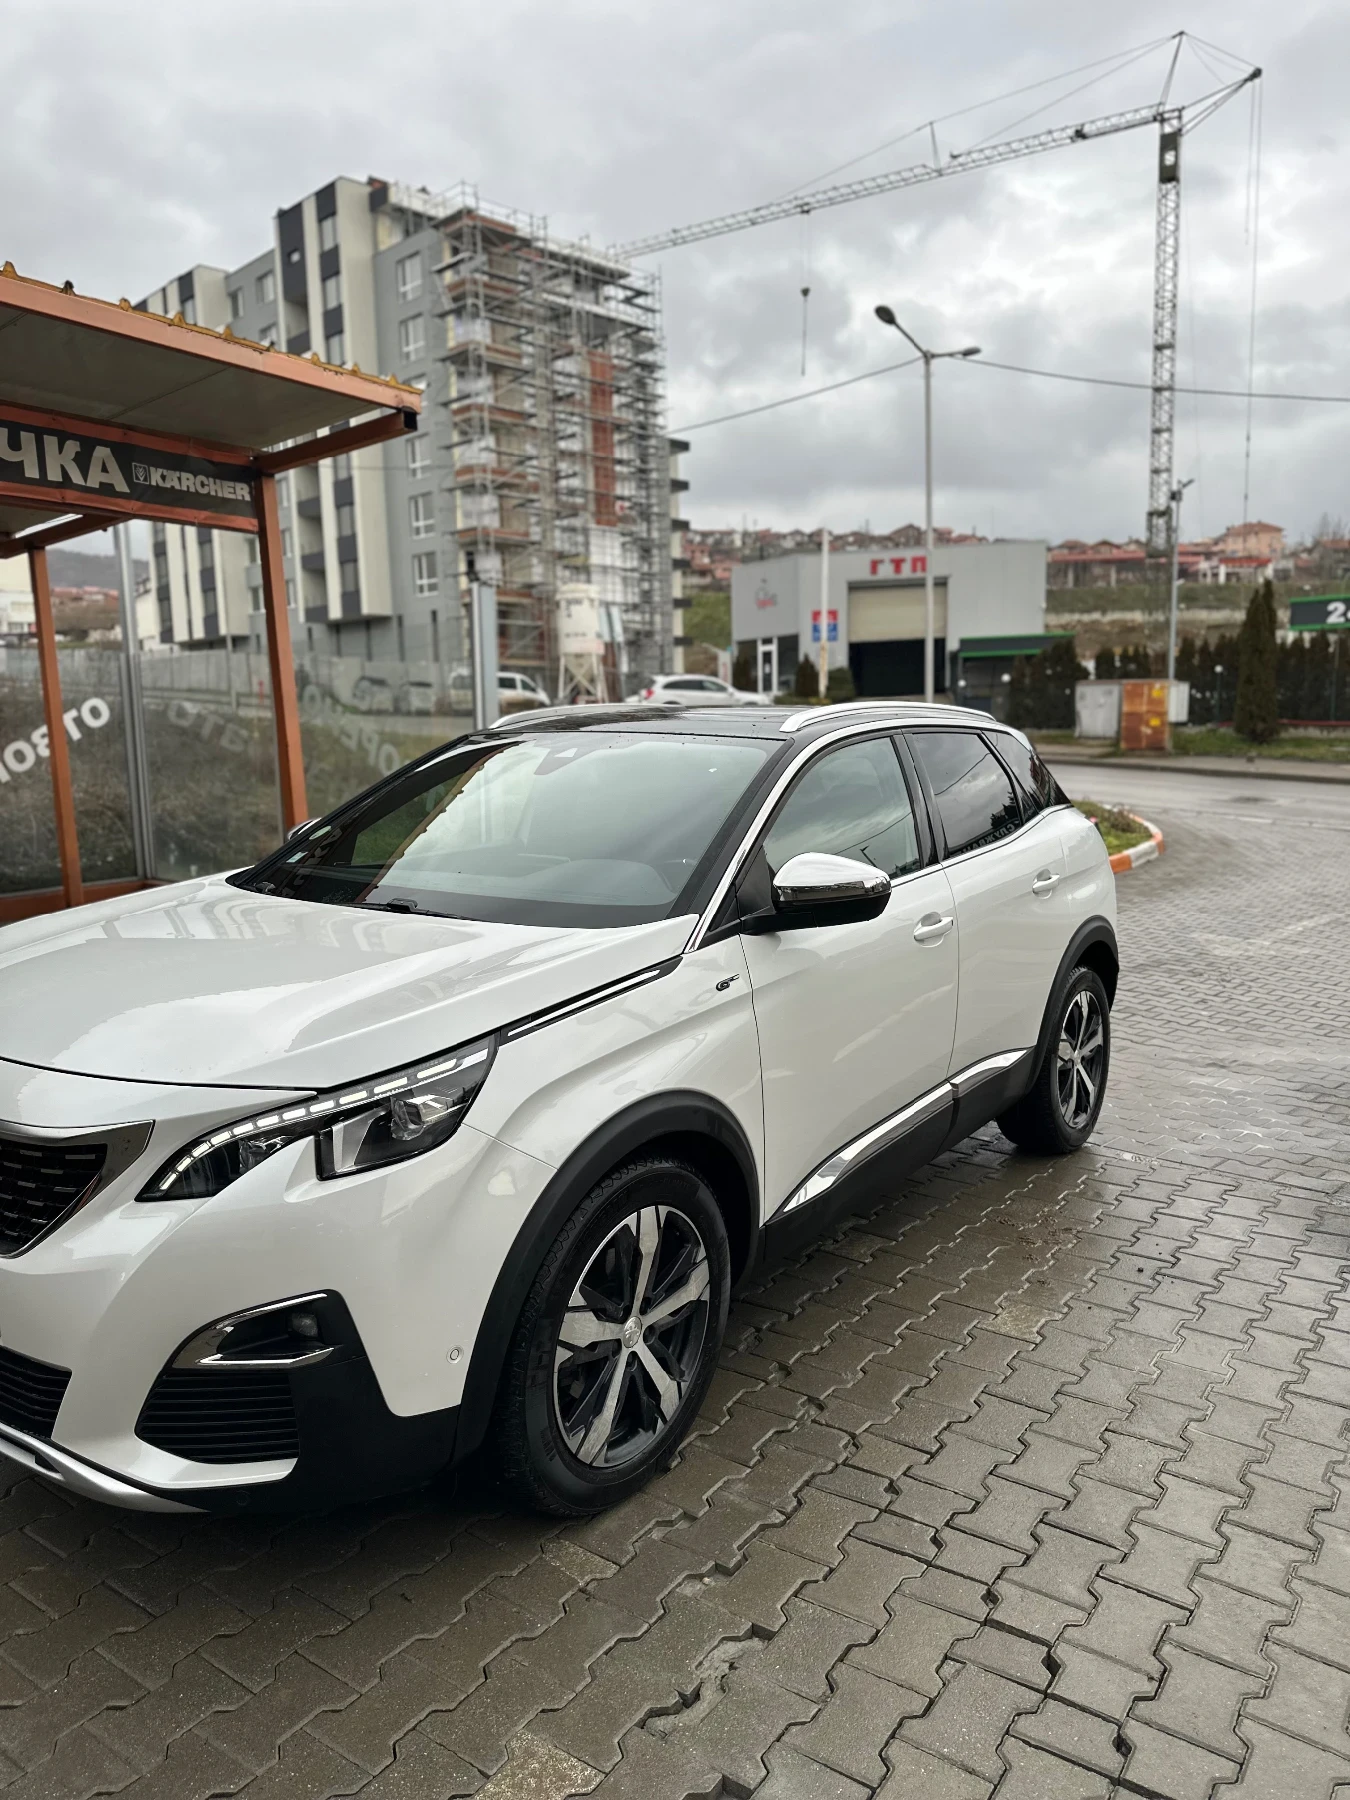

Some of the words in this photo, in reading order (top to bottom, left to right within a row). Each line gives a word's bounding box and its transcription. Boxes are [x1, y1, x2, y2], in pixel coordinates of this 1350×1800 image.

[0, 427, 130, 493] ЧКА
[149, 466, 252, 501] KÄRCHER
[869, 555, 927, 576] ГТП
[1325, 600, 1350, 624] 2
